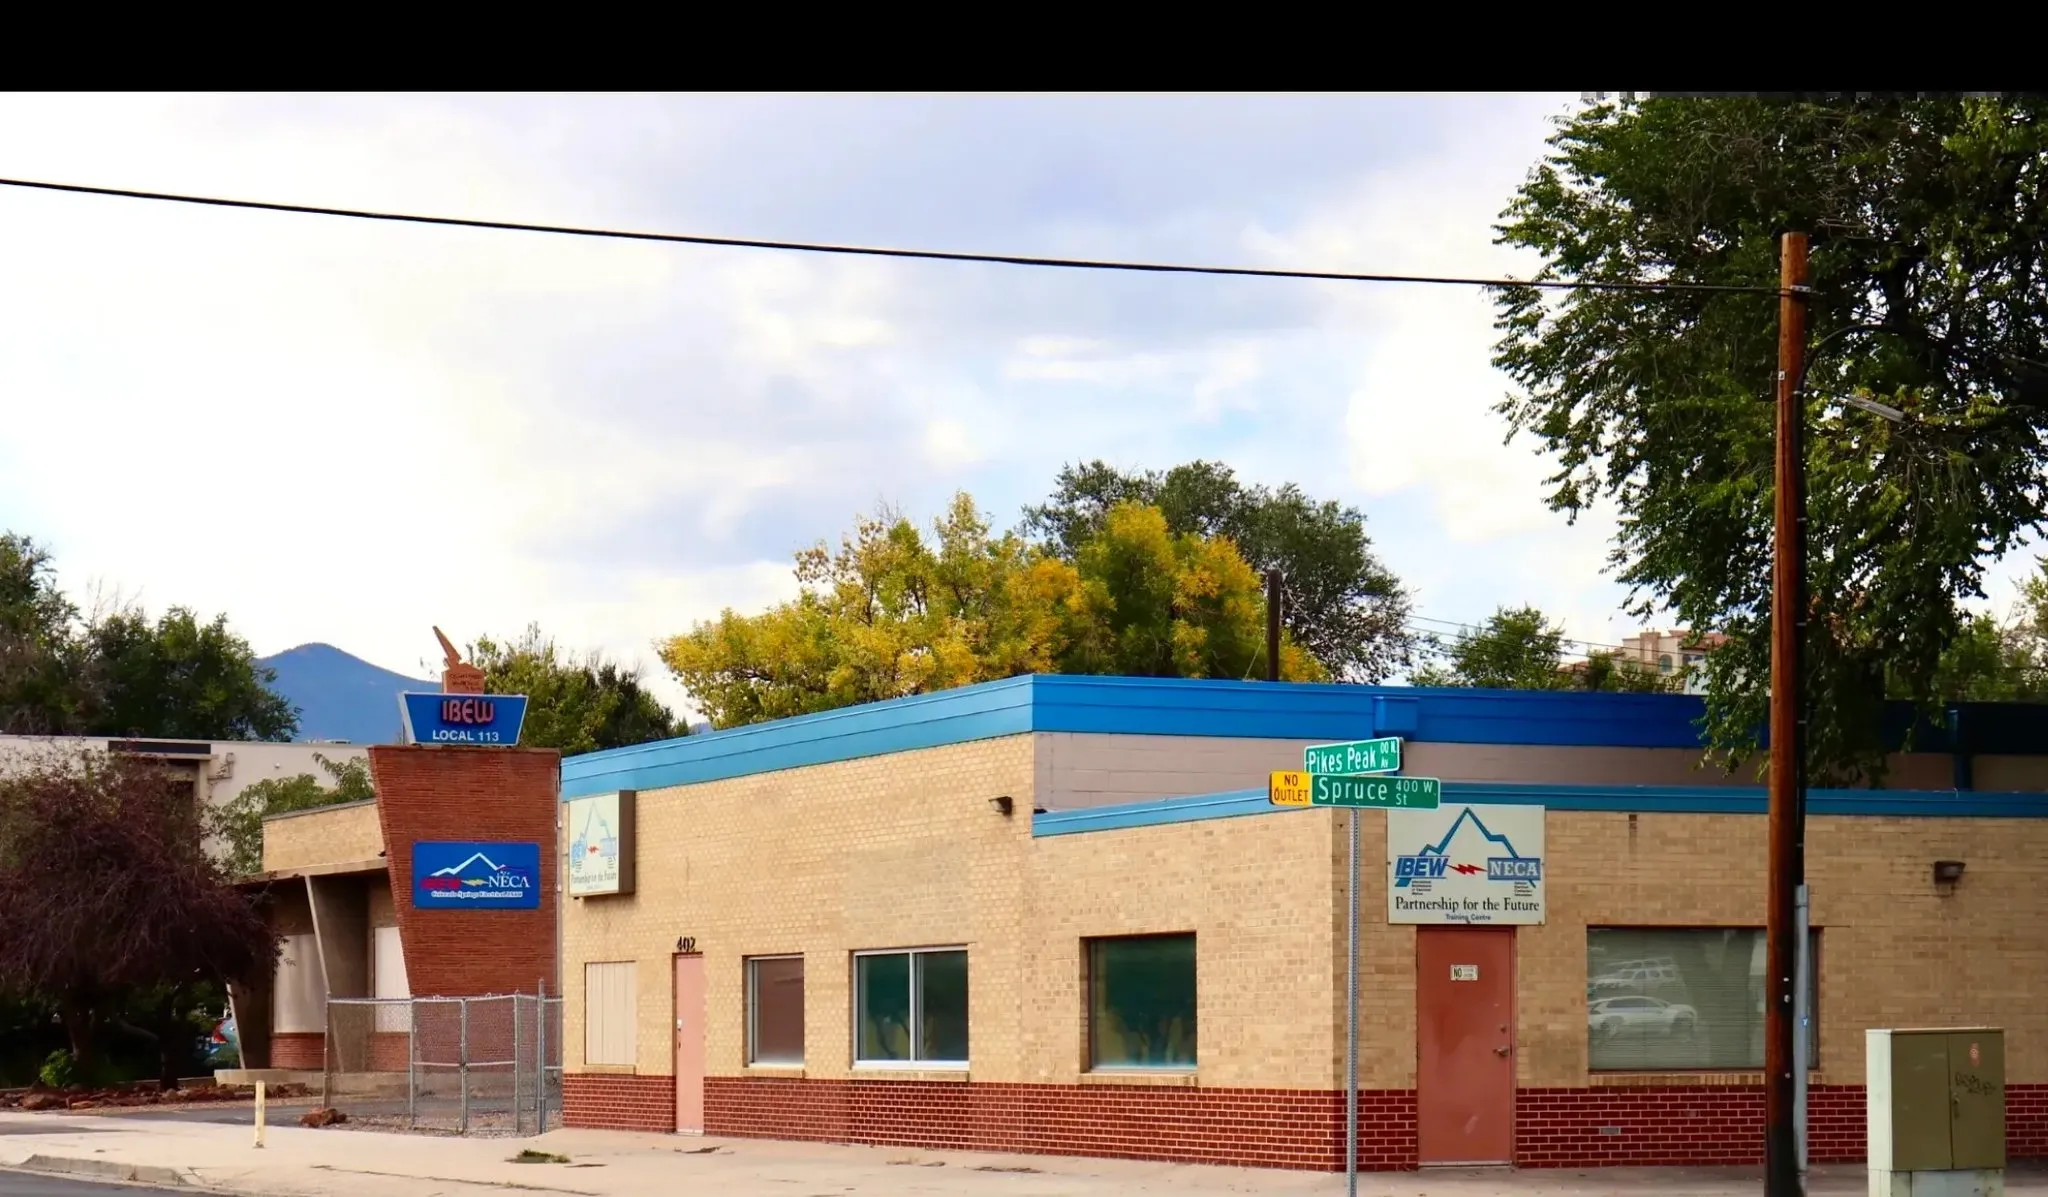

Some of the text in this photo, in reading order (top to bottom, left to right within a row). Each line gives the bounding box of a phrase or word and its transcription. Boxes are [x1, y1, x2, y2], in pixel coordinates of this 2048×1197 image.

[443, 699, 494, 723] IBEW
[432, 730, 499, 741] LOCAL 113
[1380, 742, 1389, 754] 00
[1308, 746, 1376, 773] Pikes Peak
[1284, 775, 1298, 786] NO
[1396, 780, 1433, 793] 400 W
[1274, 789, 1308, 802] OUTLET
[1318, 777, 1388, 803] Spruce
[1396, 794, 1407, 805] St
[1395, 857, 1448, 876] IBEW
[1489, 860, 1538, 876] NECA
[488, 873, 530, 888] NECA
[1395, 896, 1540, 912] Partnership for the Future
[1446, 913, 1469, 921] Training
[676, 936, 696, 951] 402
[1453, 967, 1462, 978] NO
